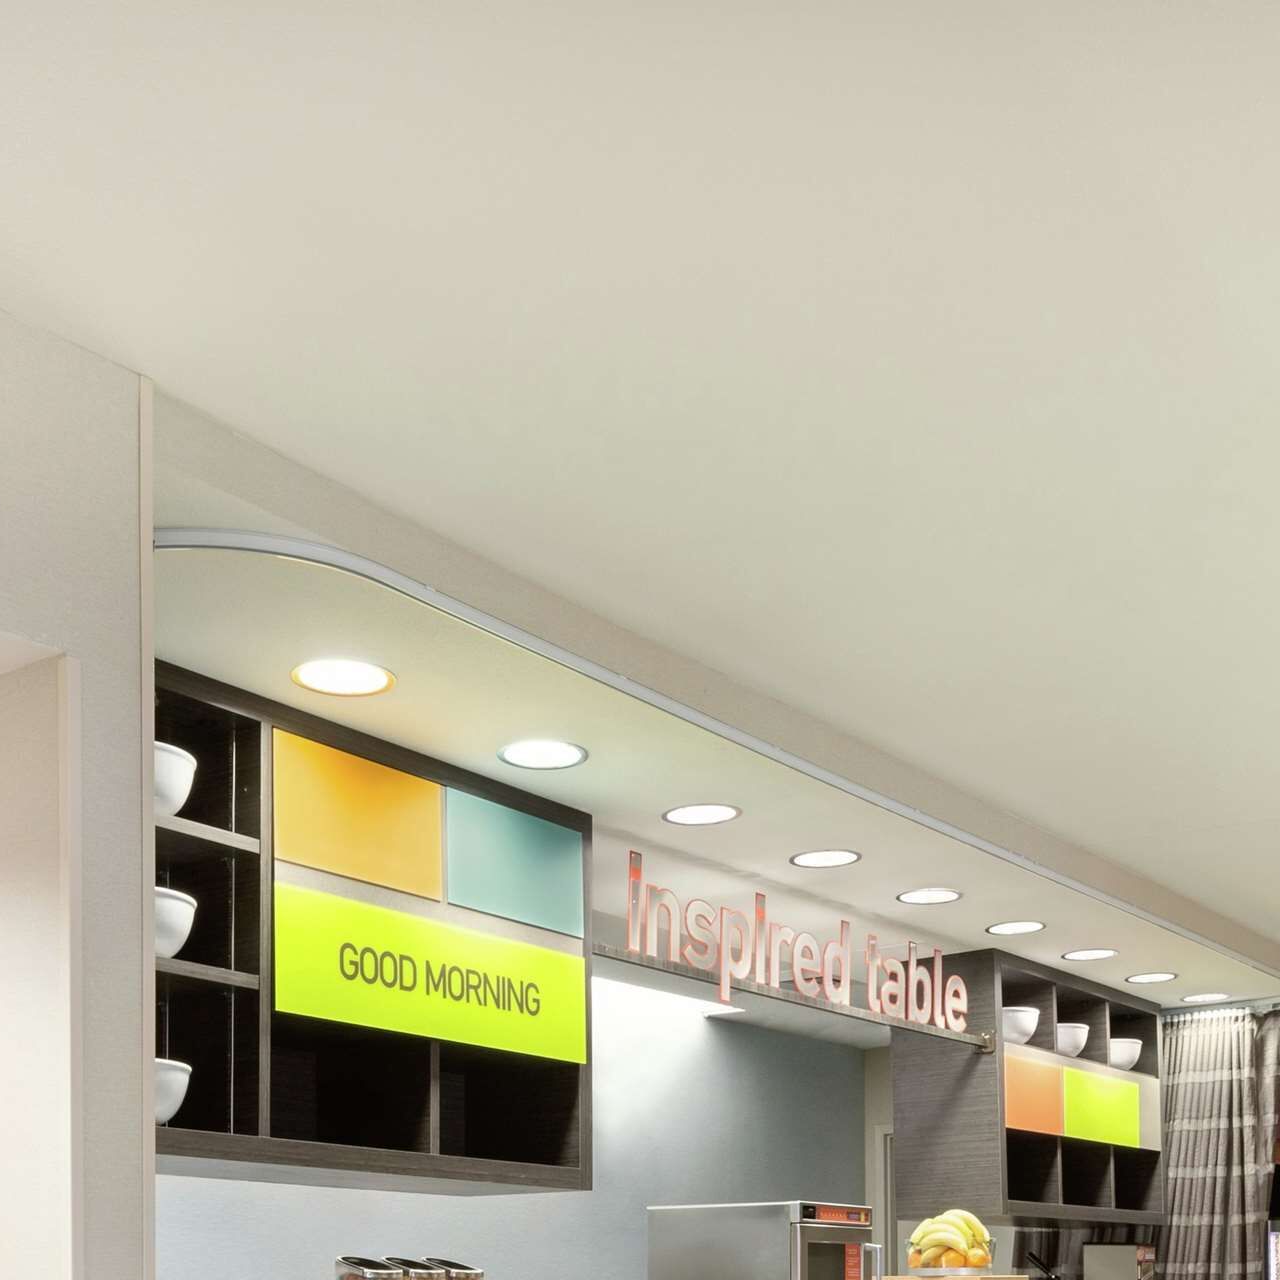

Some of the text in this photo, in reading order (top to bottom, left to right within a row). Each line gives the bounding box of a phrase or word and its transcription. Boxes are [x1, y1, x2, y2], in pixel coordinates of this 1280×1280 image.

[339, 942, 541, 1017] GOOD MORNING
[864, 933, 969, 1034] table
